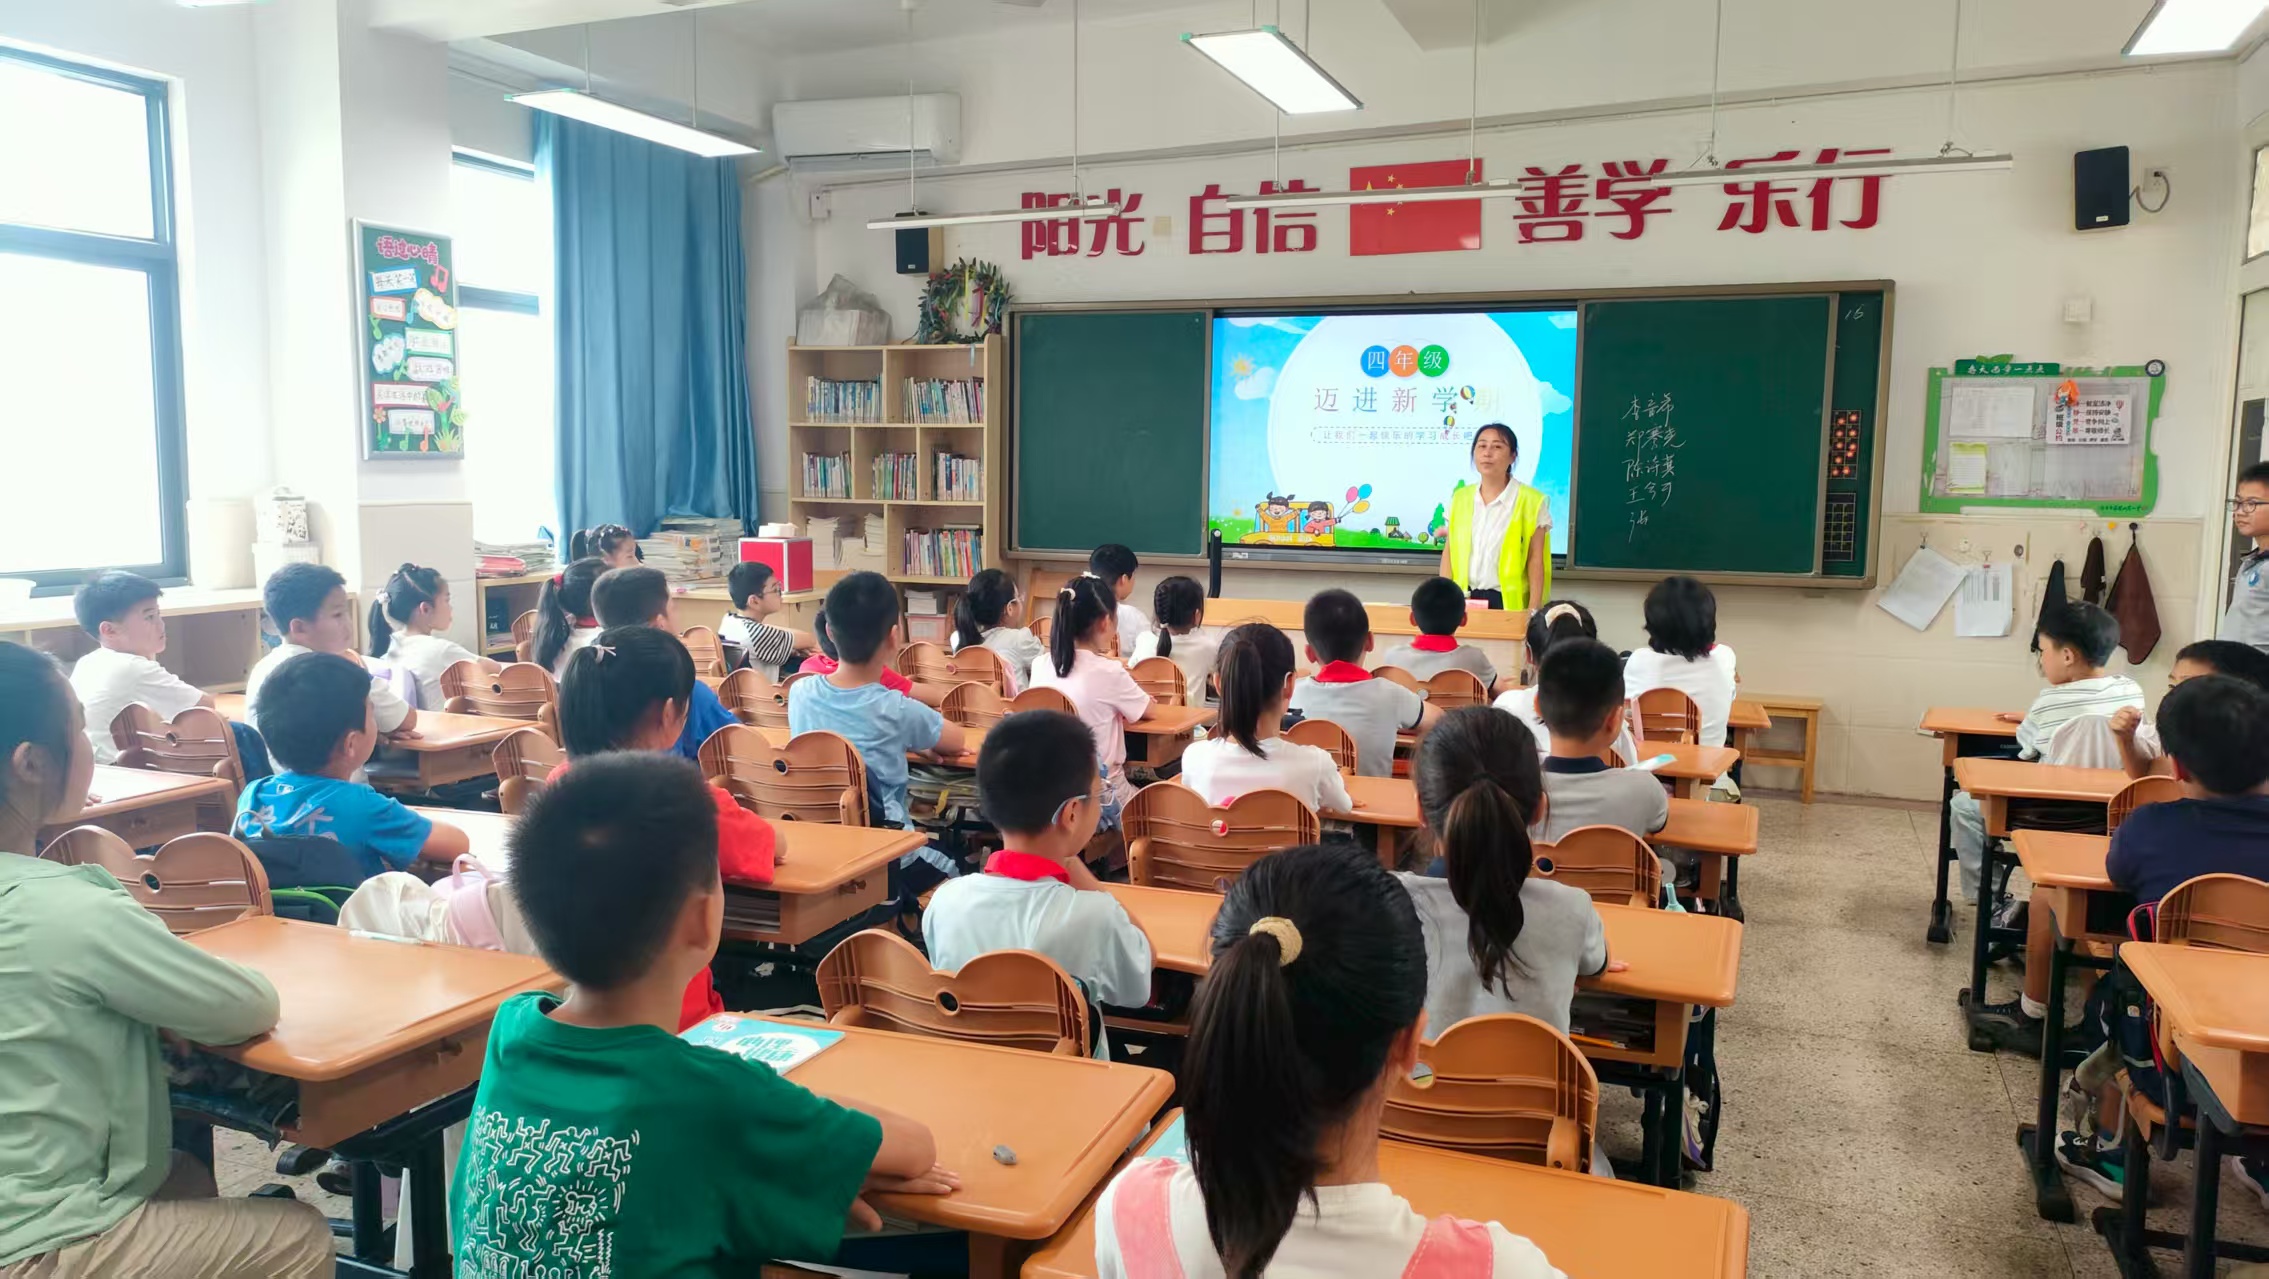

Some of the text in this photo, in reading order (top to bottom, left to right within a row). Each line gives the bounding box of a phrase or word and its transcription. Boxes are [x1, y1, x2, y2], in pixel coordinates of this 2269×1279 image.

[1021, 148, 1893, 260] 阳光 自信 善学 乐行
[1366, 350, 1444, 371] 四年级
